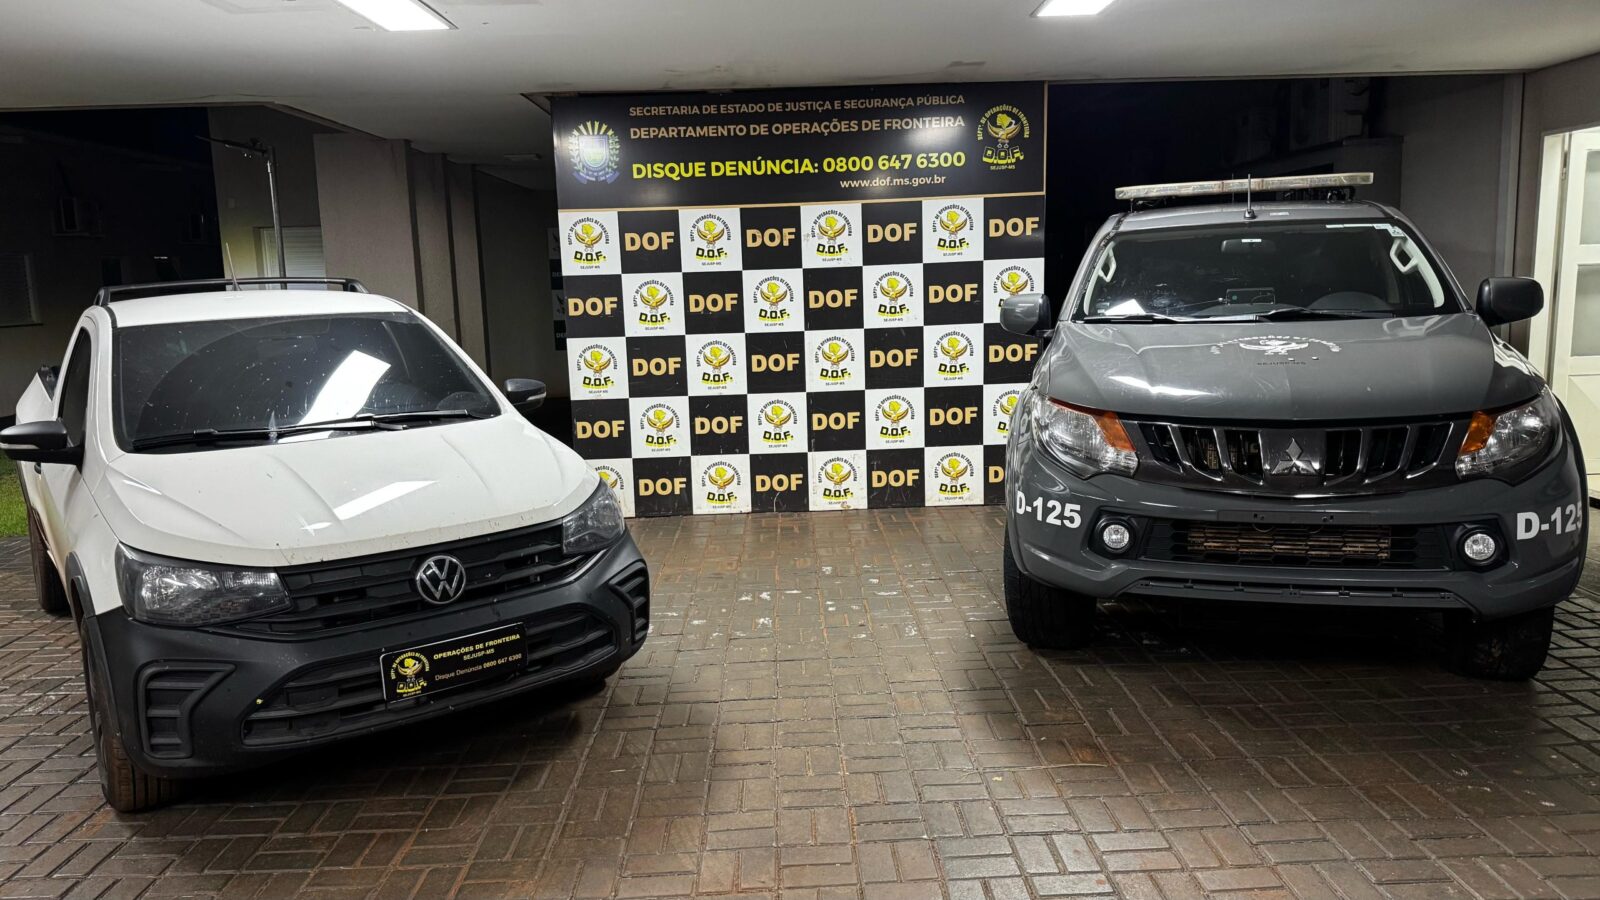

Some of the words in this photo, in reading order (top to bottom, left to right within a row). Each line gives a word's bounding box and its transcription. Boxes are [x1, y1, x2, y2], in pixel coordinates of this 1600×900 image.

[629, 105, 700, 116] SECRETARIA
[702, 104, 718, 114] DE
[720, 103, 765, 114] ESTADO
[768, 102, 783, 112] DE
[785, 100, 832, 112] JUSTIÇA
[834, 100, 842, 110] E
[843, 97, 914, 109] SEGURANÇA
[917, 94, 965, 106] PÚBLICA
[630, 125, 747, 139] DEPARTAMENTO
[750, 124, 769, 135] DE
[772, 119, 859, 136] OPERAÇÕES
[862, 119, 881, 131] DE
[884, 115, 966, 131] FRONTEIRA
[632, 162, 706, 181] DISQUE
[711, 156, 819, 177] DENÚNCIA:
[822, 156, 874, 173] 0800
[877, 154, 912, 171] 647
[916, 151, 966, 168] 6300
[840, 174, 946, 188] www.dof.ms.gov.br
[868, 224, 916, 243] DOF
[989, 217, 1039, 238] DOF
[625, 231, 675, 251] DOF
[747, 228, 795, 247] DOF
[938, 238, 969, 249] D.O.F.
[574, 251, 606, 262] D.O.F.
[696, 247, 727, 259] D.O.F.
[816, 243, 848, 255] D.O.F.
[809, 289, 857, 308] DOF
[929, 284, 977, 303] DOF
[568, 297, 617, 316] DOF
[689, 294, 737, 312] DOF
[878, 304, 909, 315] D.O.F.
[639, 312, 670, 324] D.O.F.
[759, 309, 790, 320] D.O.F.
[870, 349, 918, 367] DOF
[989, 344, 1038, 363] DOF
[633, 358, 681, 376] DOF
[752, 354, 800, 373] DOF
[938, 363, 969, 374] D.O.F.
[583, 376, 614, 387] D.O.F.
[702, 372, 733, 383] D.O.F.
[820, 368, 851, 379] D.O.F.
[695, 416, 742, 434] DOF
[812, 412, 860, 431] DOF
[930, 407, 977, 425] DOF
[577, 420, 624, 438] DOF
[763, 431, 794, 442] D.O.F.
[880, 426, 911, 437] D.O.F.
[646, 435, 676, 446] D.O.F.
[639, 478, 686, 496] DOF
[756, 474, 802, 492] DOF
[872, 469, 919, 487] DOF
[707, 492, 737, 503] D.O.F.
[823, 488, 853, 499] D.O.F.
[939, 483, 970, 494] D.O.F.
[1016, 490, 1082, 529] D-125
[1516, 501, 1582, 540] D-125
[433, 645, 474, 660] OPERAÇÕES
[475, 643, 485, 651] DE
[485, 634, 520, 648] FRONTEIRA
[463, 648, 495, 661] SEJUSP-MS
[435, 670, 455, 681] Disque
[456, 664, 483, 675] Denúncia
[498, 657, 508, 665] 647
